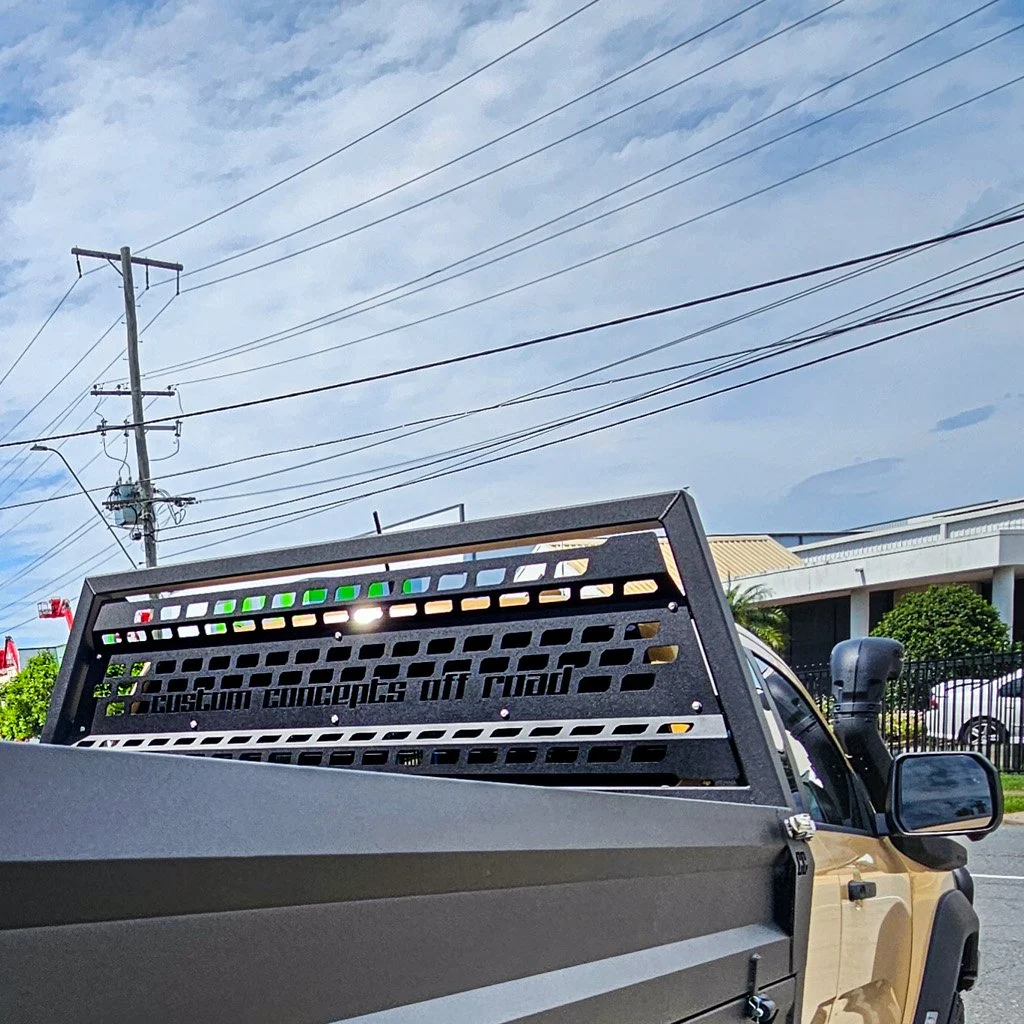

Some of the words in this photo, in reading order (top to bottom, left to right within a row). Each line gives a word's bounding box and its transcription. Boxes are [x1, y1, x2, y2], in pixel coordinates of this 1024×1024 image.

[150, 687, 252, 714] custom
[263, 677, 407, 709] concepts
[420, 672, 471, 701] off
[482, 665, 574, 699] road
